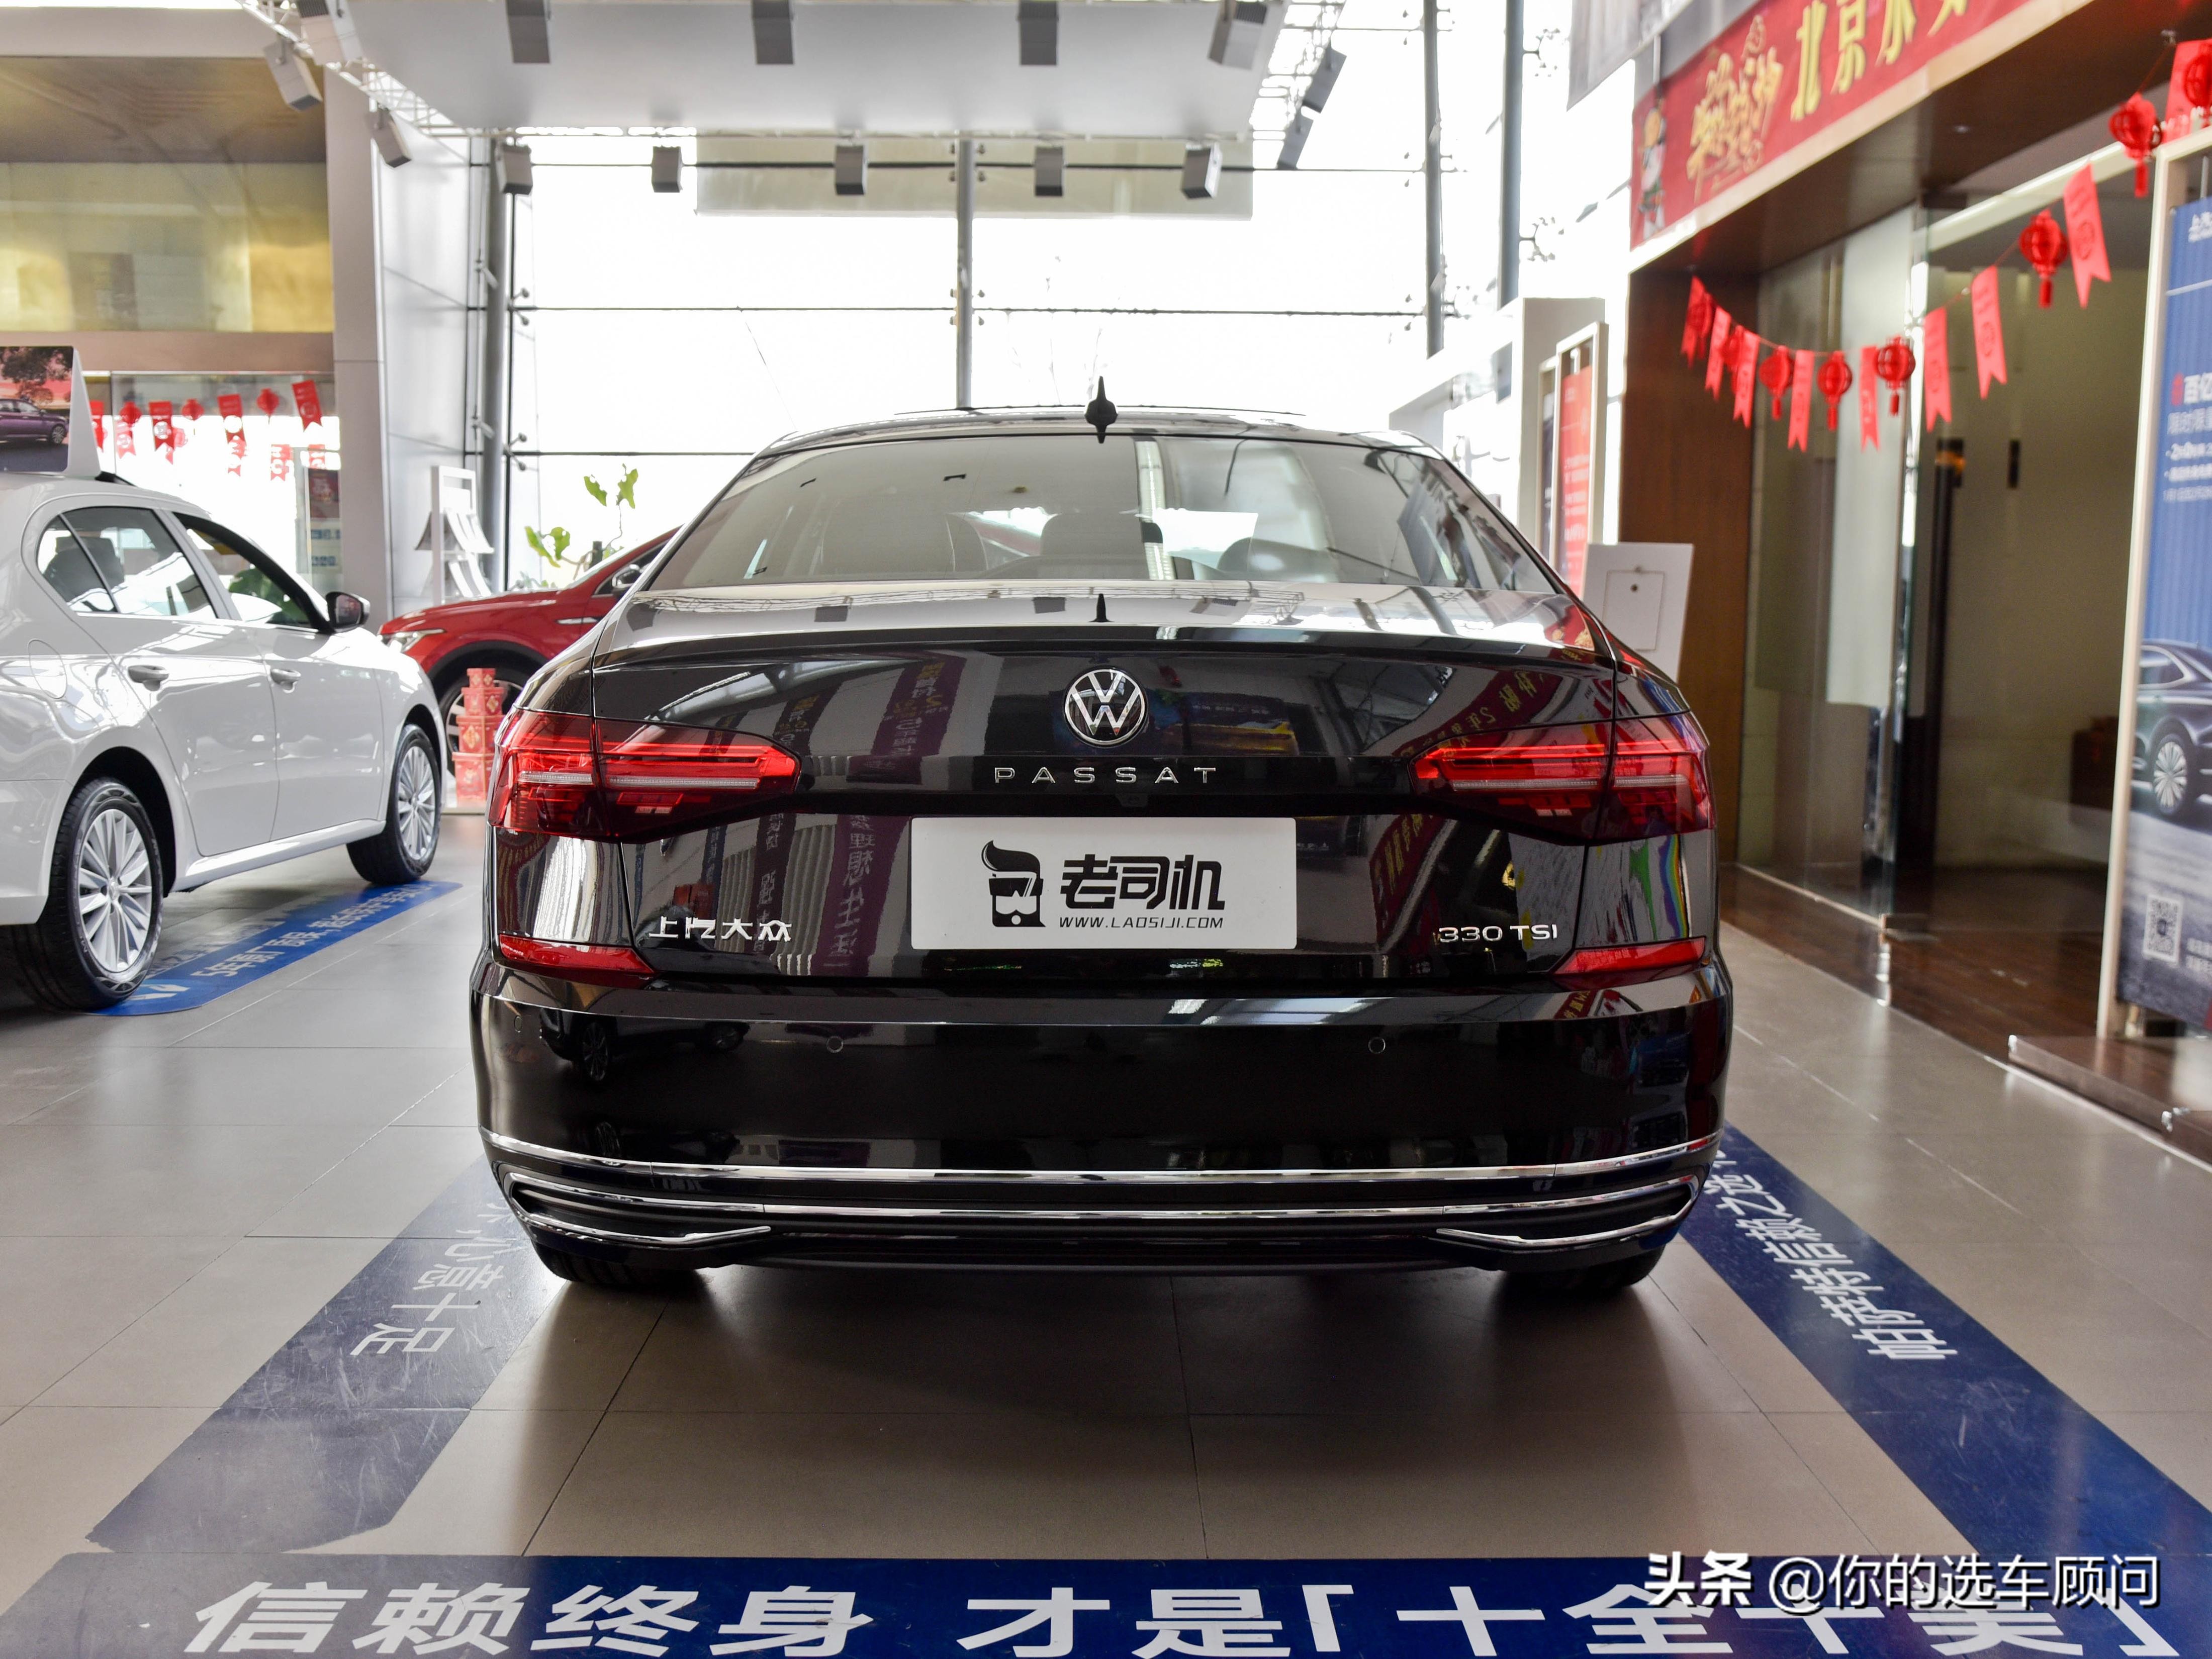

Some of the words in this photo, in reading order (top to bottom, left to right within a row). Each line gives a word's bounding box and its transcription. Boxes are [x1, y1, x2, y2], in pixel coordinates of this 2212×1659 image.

[994, 766, 1216, 784] PASSAT
[1060, 854, 1225, 910] 老司机
[649, 916, 792, 942] 上汽大众
[1059, 916, 1224, 929] WWW.LAOSIJI.COM
[1439, 926, 1503, 943] 330
[1510, 924, 1557, 941] TSI
[184, 1581, 874, 1656] 信赖终身
